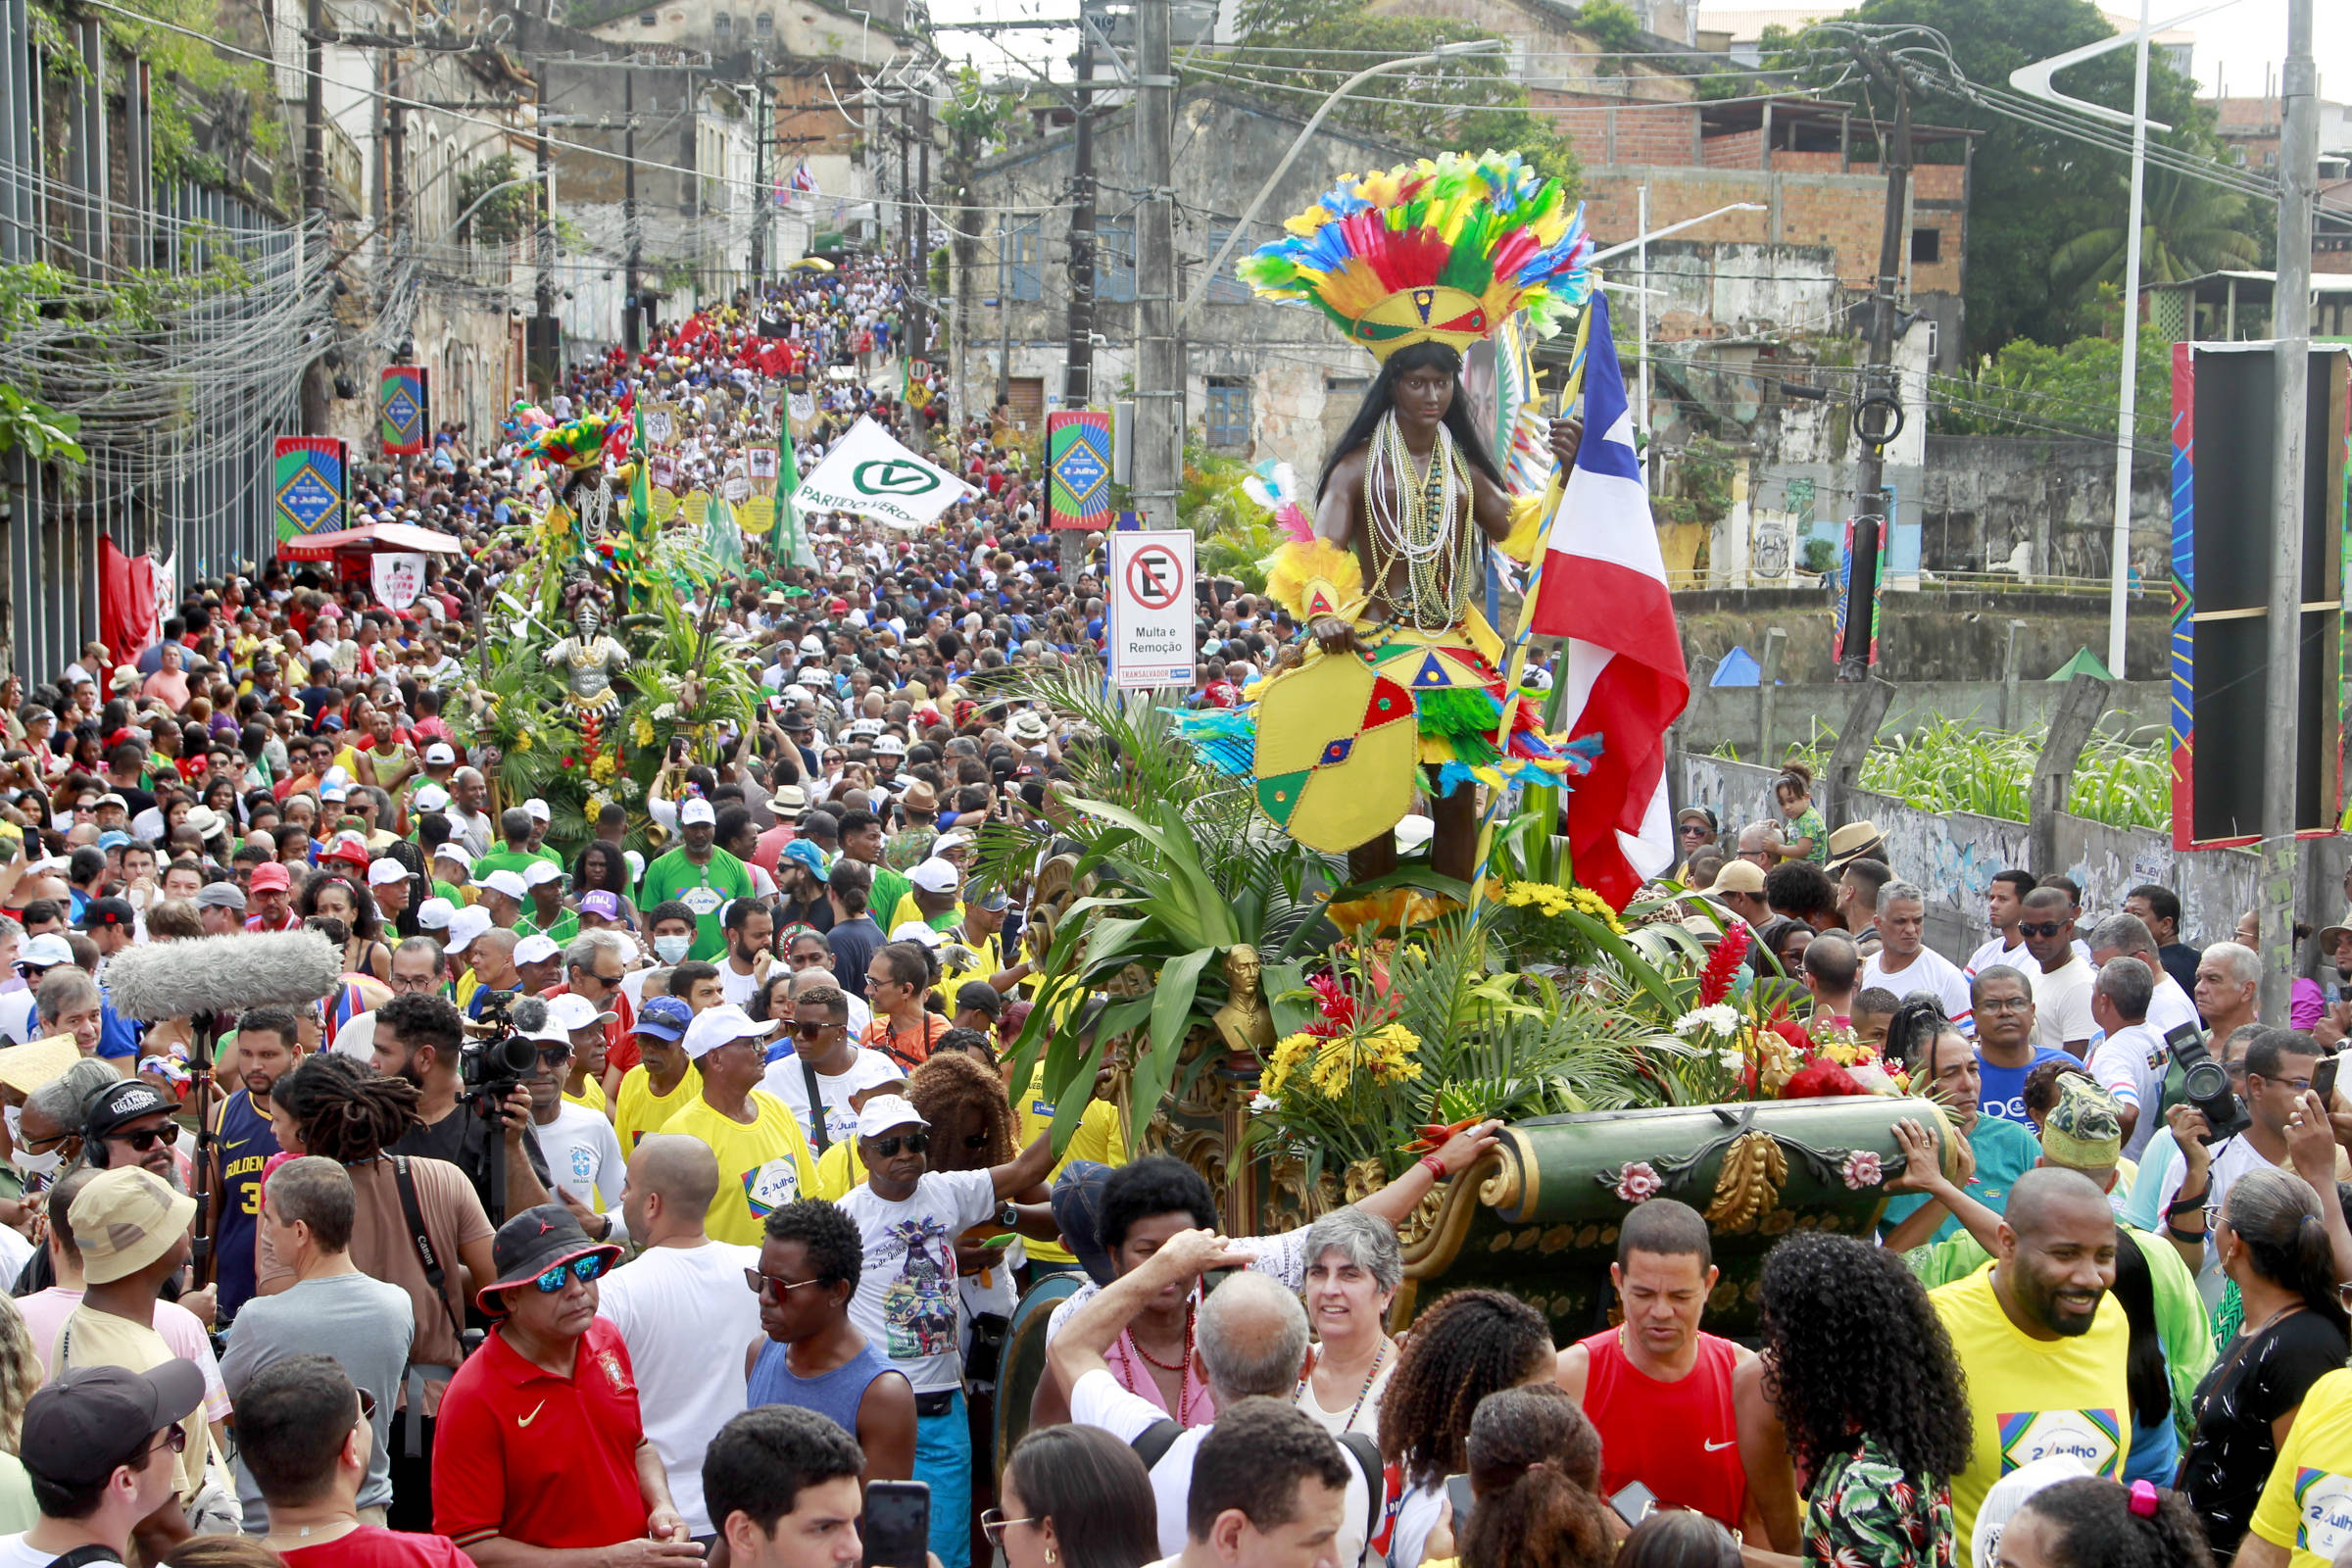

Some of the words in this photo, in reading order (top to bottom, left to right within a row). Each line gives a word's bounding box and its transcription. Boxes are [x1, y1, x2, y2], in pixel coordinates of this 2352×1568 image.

[288, 495, 297, 505] 2
[299, 495, 328, 505] Julho
[801, 485, 867, 510] PARTIDO
[1136, 627, 1166, 638] Multa
[1169, 628, 1176, 637] e
[1129, 641, 1182, 655] Remoção
[1121, 669, 1169, 678] TRANSALVADOR
[760, 1186, 768, 1196] 2
[771, 1176, 795, 1192] Julho
[417, 1235, 434, 1265] Canon
[887, 1246, 907, 1260] Julho
[2032, 1446, 2044, 1461] 2
[2310, 1505, 2324, 1520] 2
